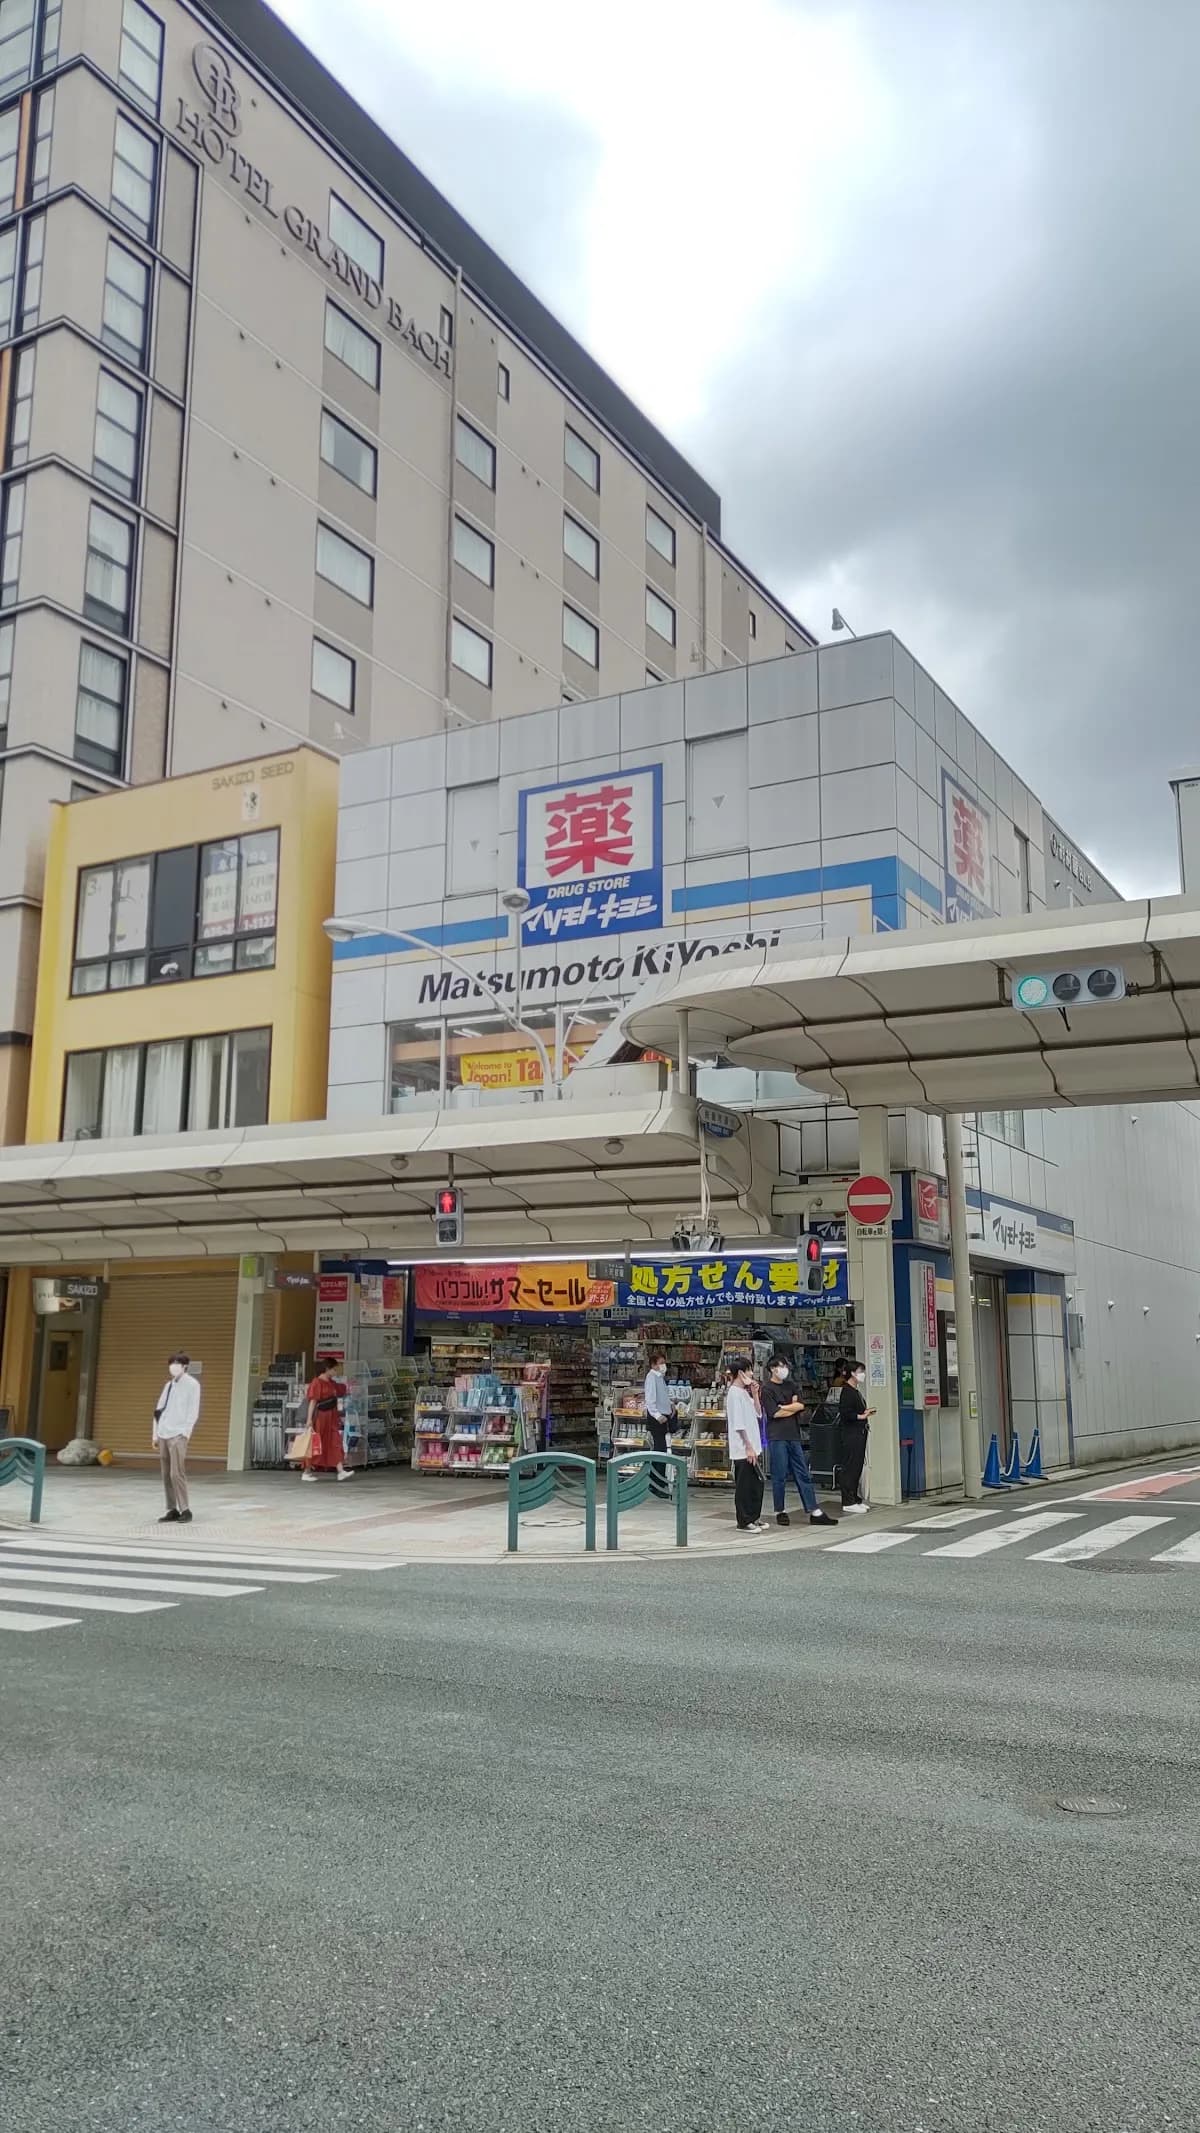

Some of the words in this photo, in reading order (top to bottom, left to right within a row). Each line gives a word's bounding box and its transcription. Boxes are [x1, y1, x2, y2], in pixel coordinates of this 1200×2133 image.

[175, 97, 279, 219] HOTEL
[283, 205, 383, 310] GRAND
[387, 296, 452, 380] BACH
[260, 761, 294, 780] SEED
[545, 785, 634, 878] 薬
[952, 794, 985, 897] 薬
[547, 883, 584, 900] DRUG
[586, 875, 631, 894] STORE
[419, 955, 625, 1005] Matsumoto
[467, 1069, 512, 1087] Japan!
[630, 1258, 840, 1296] 処方せん受付
[626, 1291, 803, 1308] 全国どこの処方せんでも受付致します。
